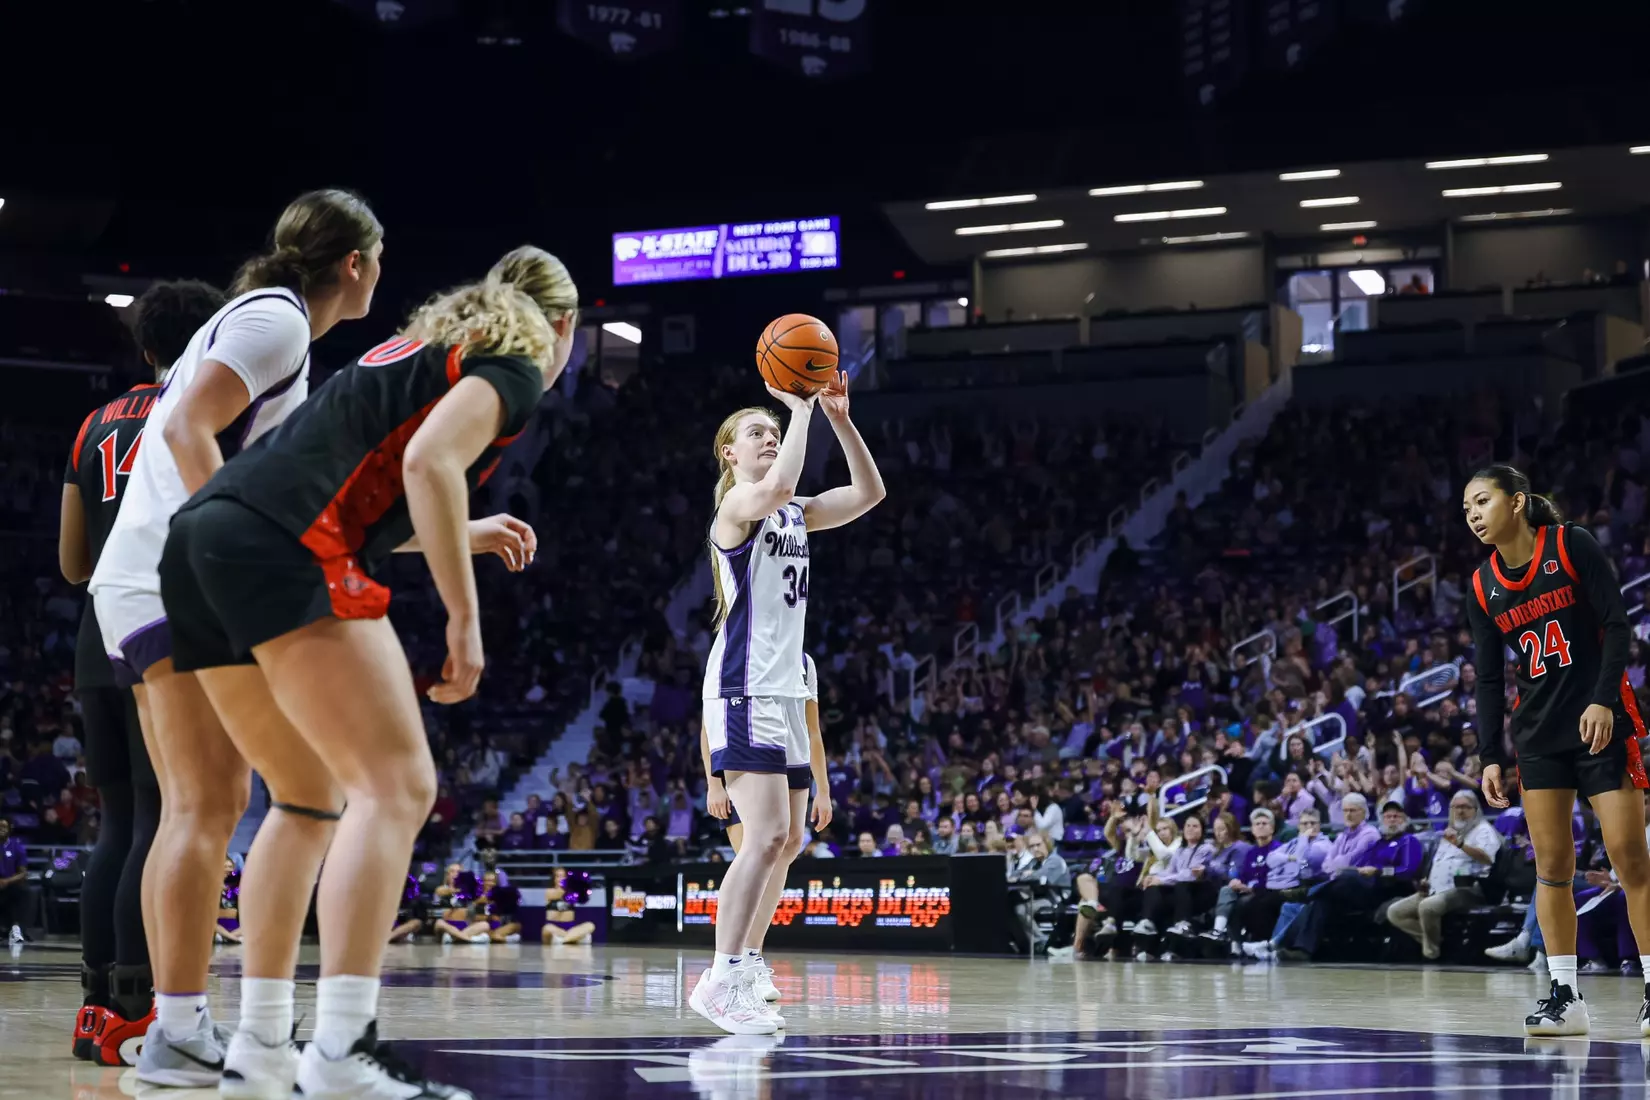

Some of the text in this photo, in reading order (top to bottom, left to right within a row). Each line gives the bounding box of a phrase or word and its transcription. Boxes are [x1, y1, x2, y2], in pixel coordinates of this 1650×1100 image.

[641, 230, 718, 254] K-STATE
[733, 218, 830, 237] NEXT HOME GAME
[782, 564, 808, 609] 34
[1509, 596, 1541, 628] DIEGO
[1538, 584, 1576, 617] STATE
[1518, 619, 1573, 679] 24
[805, 876, 873, 926] Briggs
[876, 875, 950, 928] Briggs
